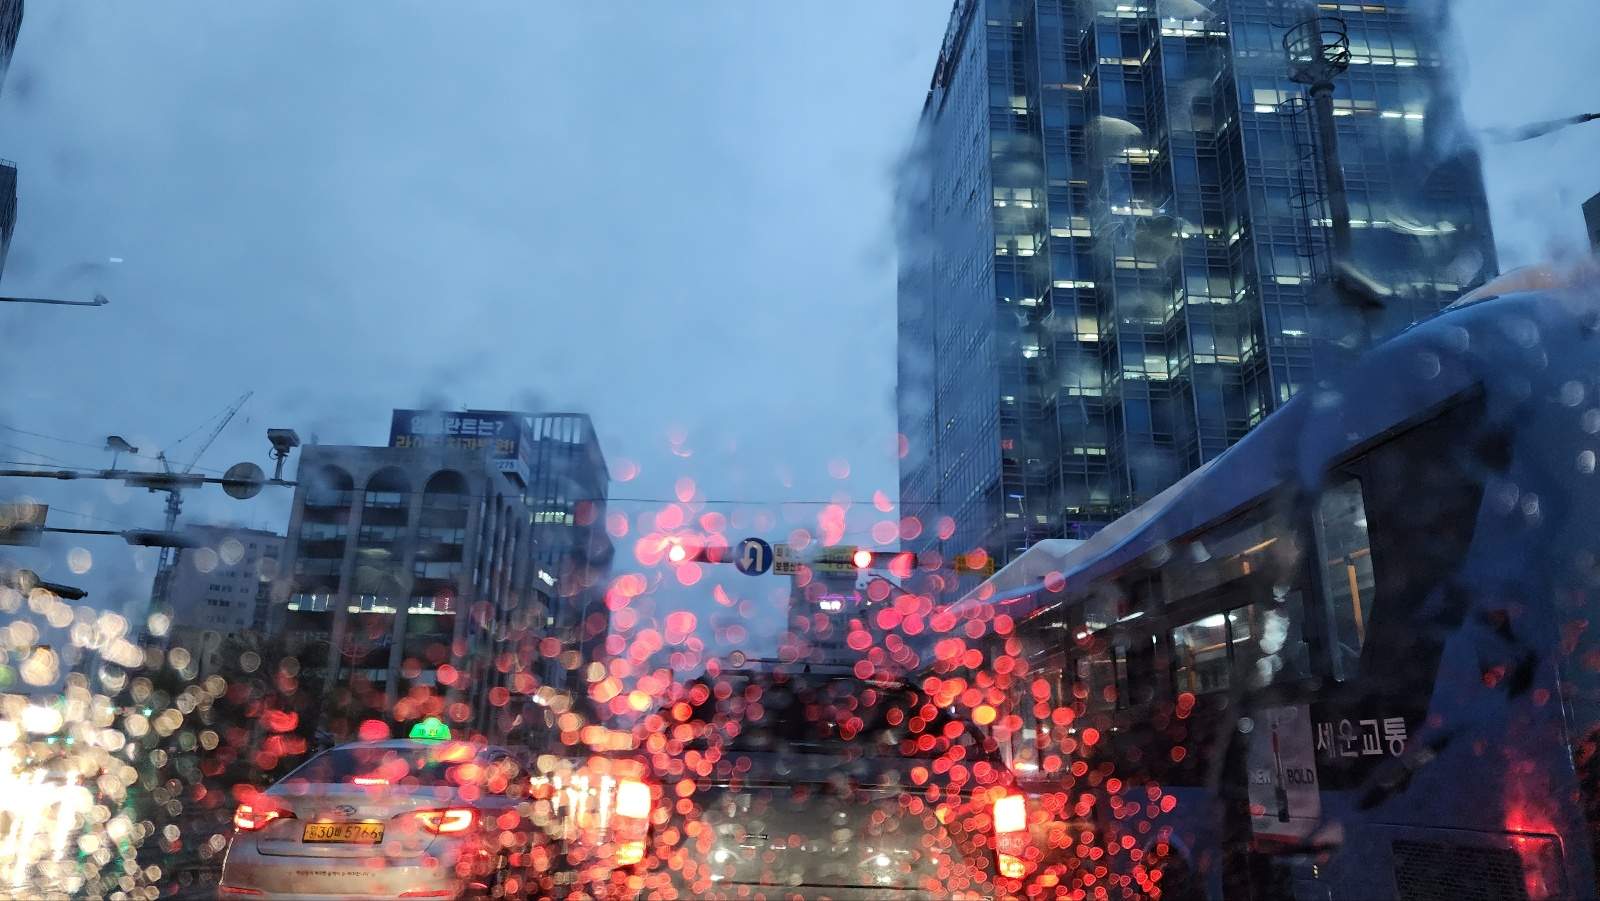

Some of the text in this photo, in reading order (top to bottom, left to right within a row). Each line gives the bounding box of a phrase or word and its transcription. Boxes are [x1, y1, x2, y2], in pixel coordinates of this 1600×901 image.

[411, 416, 504, 436] 임란트는?
[1317, 717, 1408, 758] 세운교통
[1286, 768, 1315, 785] BOLD
